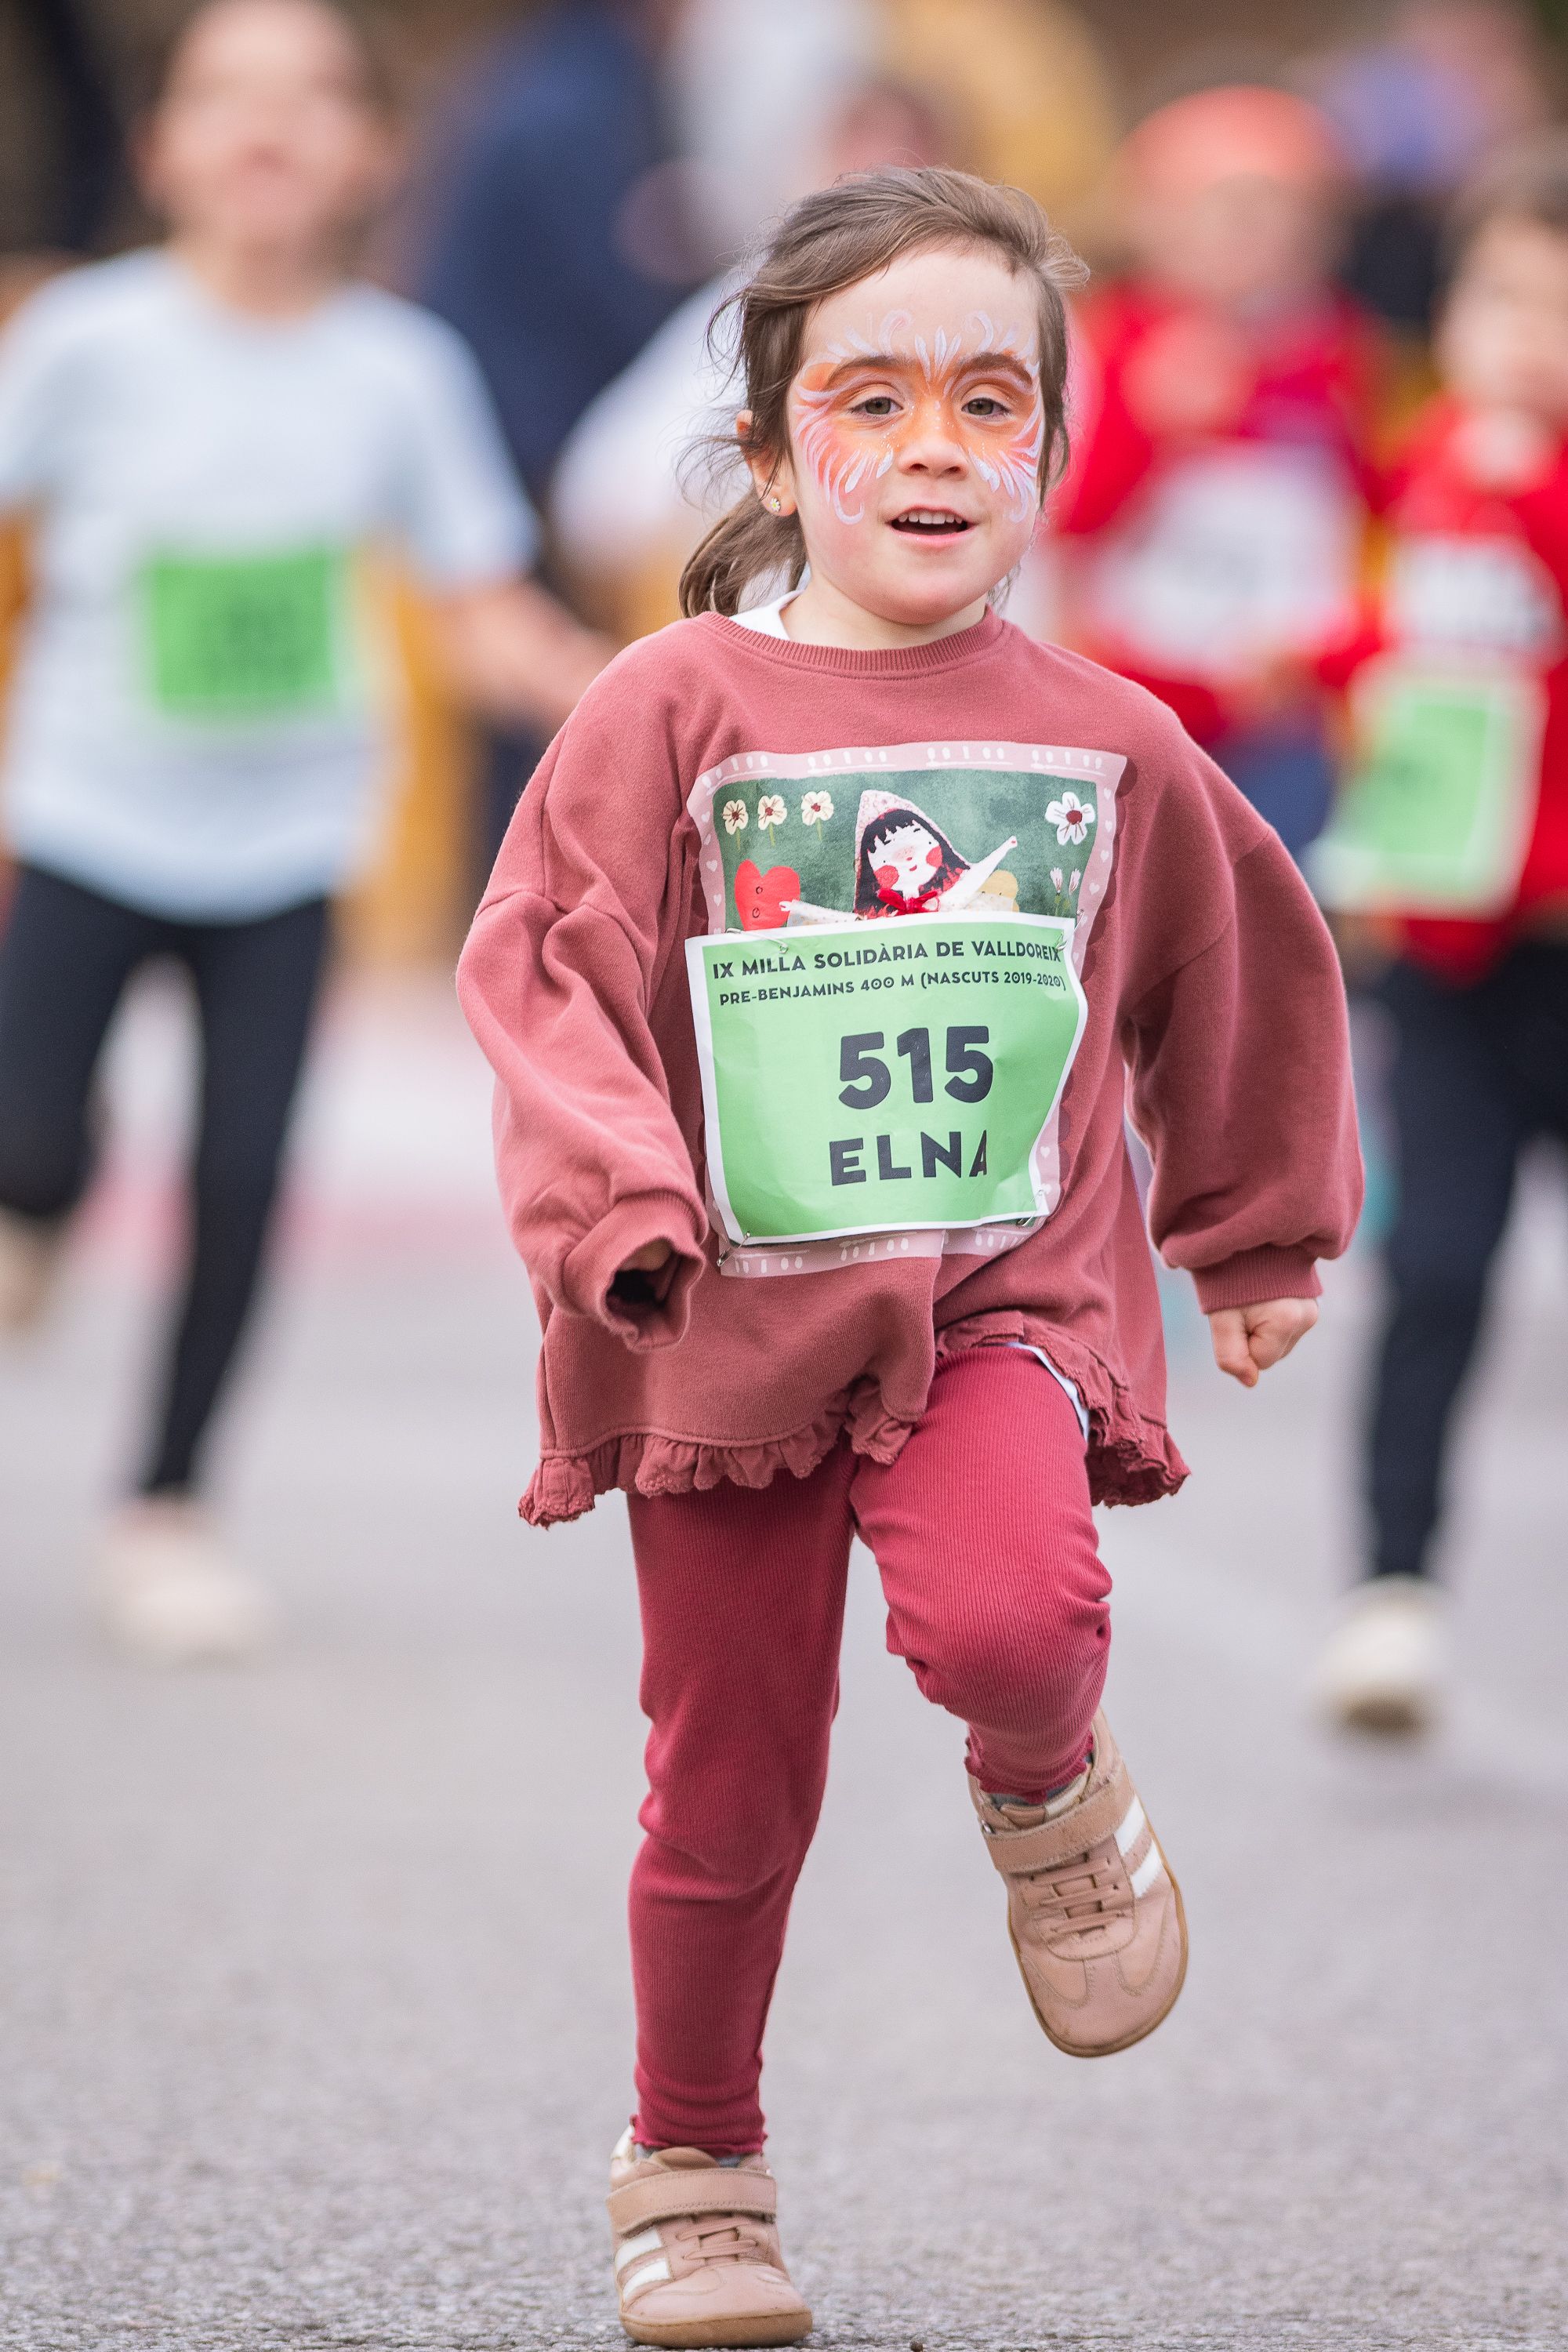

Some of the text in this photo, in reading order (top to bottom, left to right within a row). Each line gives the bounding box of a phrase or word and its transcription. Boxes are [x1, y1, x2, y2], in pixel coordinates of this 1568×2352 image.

[713, 941, 1062, 979] IX MILLA SOLIDÀRIA DE VALLDOREIX
[720, 971, 1066, 1006] PRE-BENJAMINS 400 M (NASCUTS 2019-2020)
[838, 1025, 993, 1110] 515
[829, 1129, 987, 1186] ELNA
